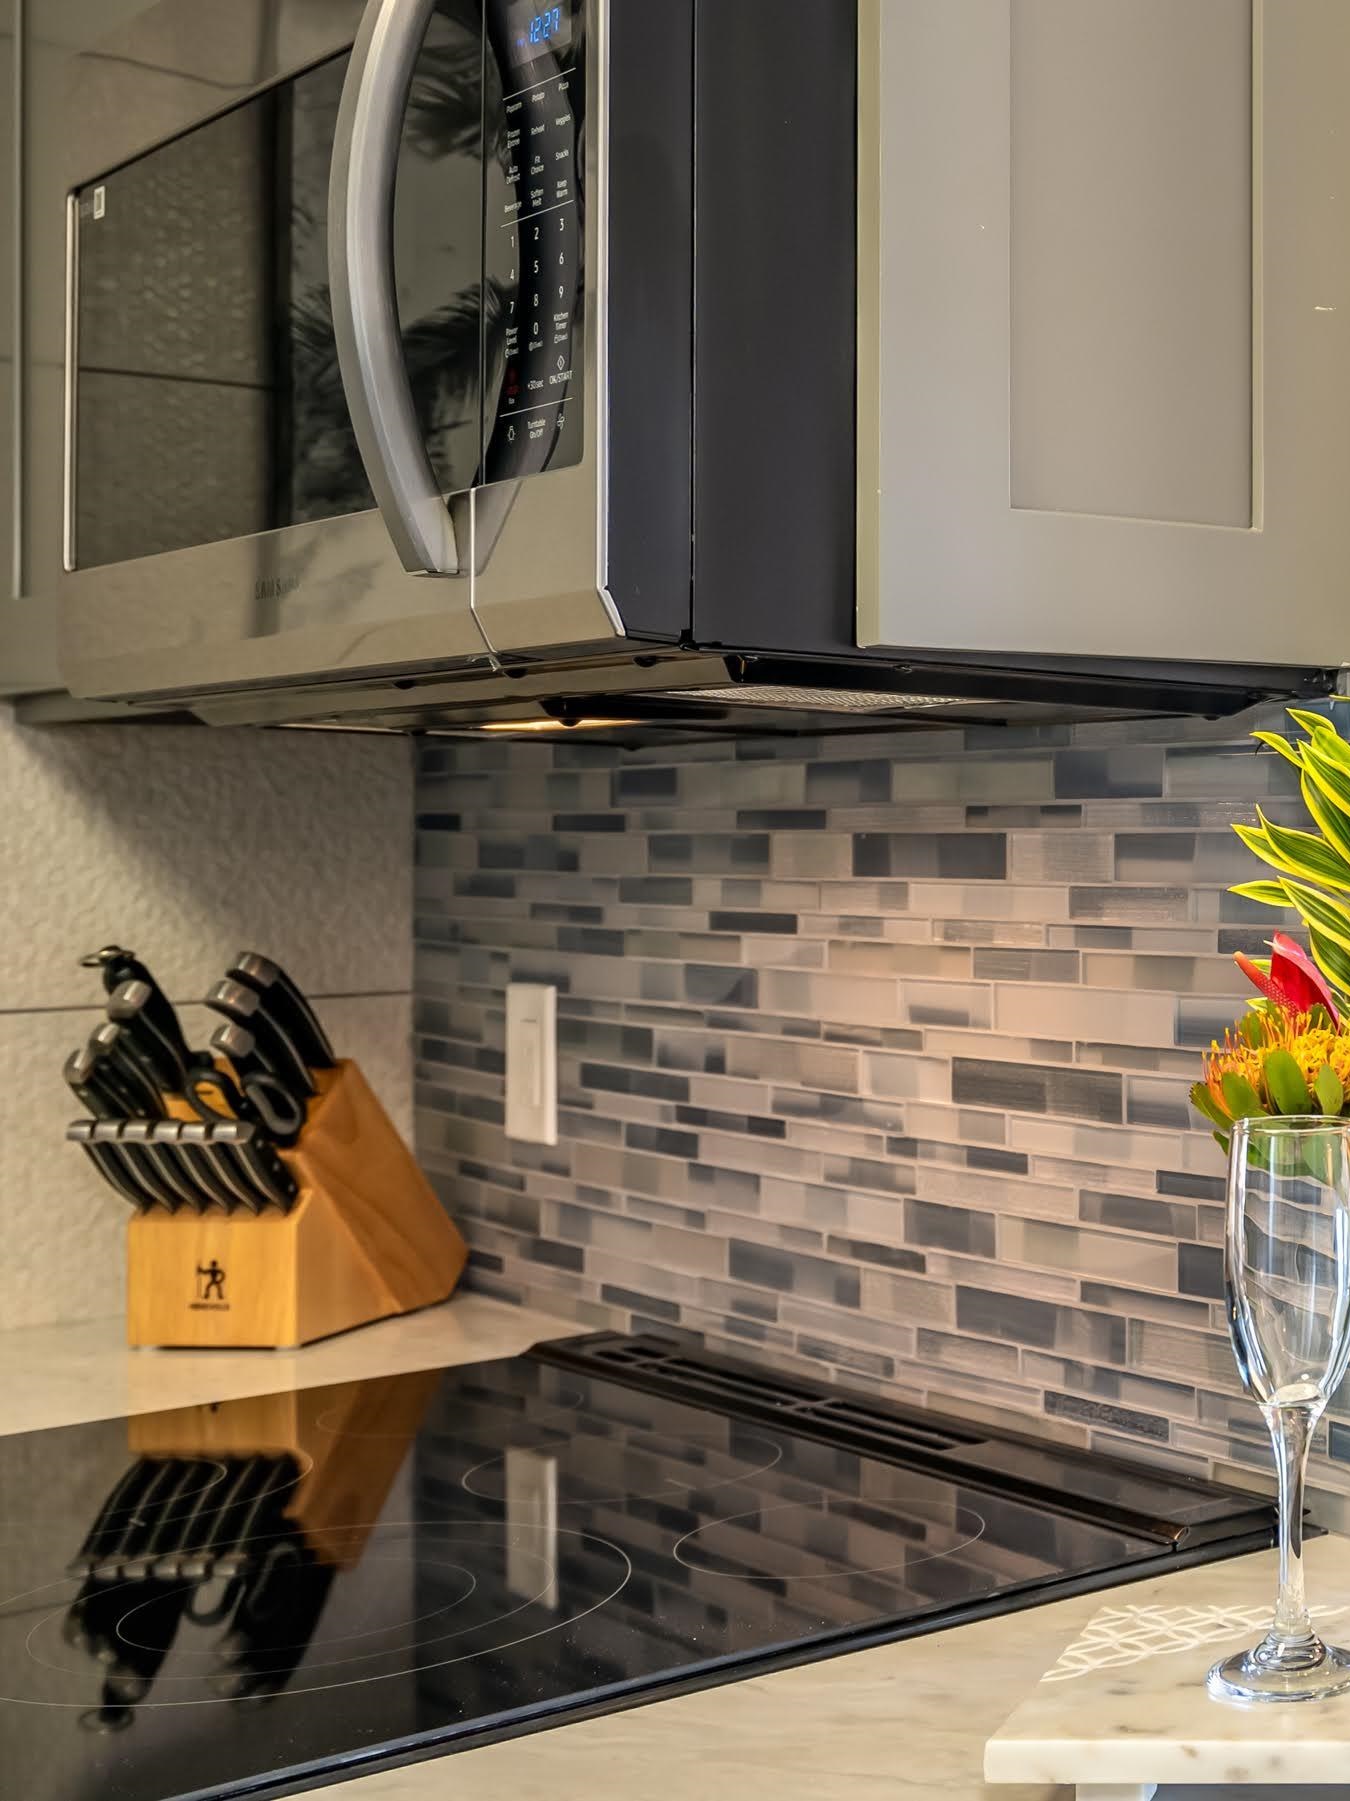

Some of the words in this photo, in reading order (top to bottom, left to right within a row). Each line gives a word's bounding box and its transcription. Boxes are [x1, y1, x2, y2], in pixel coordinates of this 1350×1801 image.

[560, 217, 564, 231] 3
[534, 226, 539, 240] 2
[511, 235, 514, 248] 1
[559, 252, 564, 265] 6
[533, 260, 539, 274] 5
[509, 268, 515, 280] 4
[559, 286, 564, 298] 9
[533, 293, 538, 307] 8
[510, 301, 515, 314] 7
[533, 322, 539, 335] 0
[549, 370, 573, 385] OK/START
